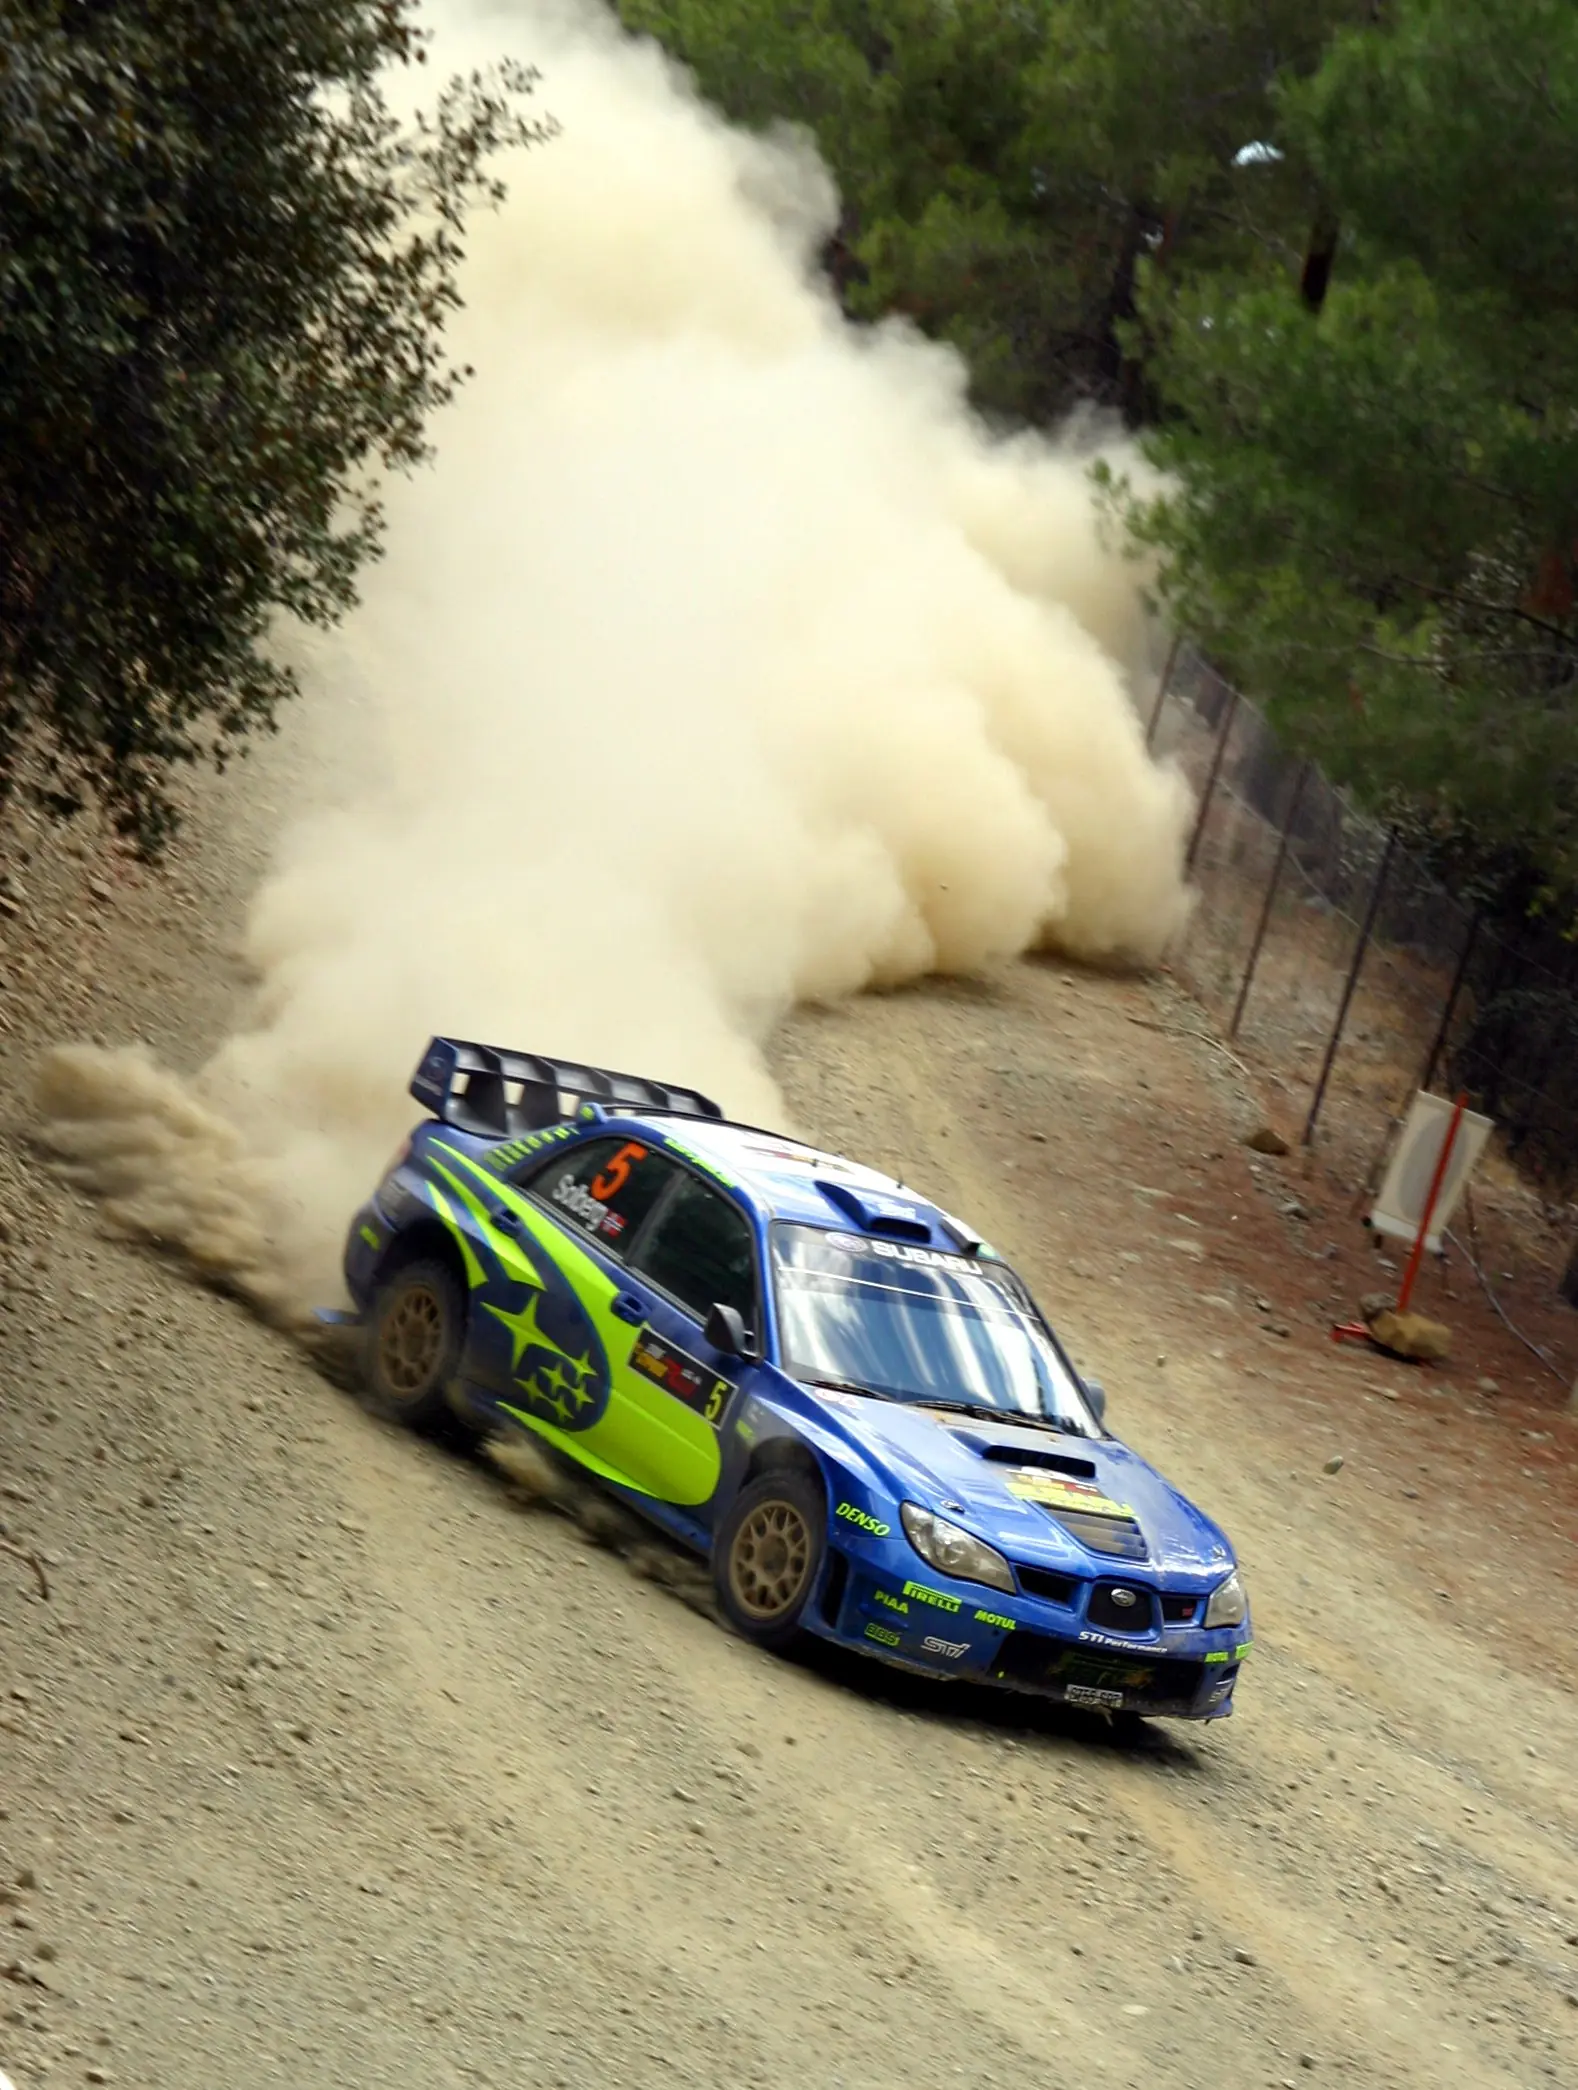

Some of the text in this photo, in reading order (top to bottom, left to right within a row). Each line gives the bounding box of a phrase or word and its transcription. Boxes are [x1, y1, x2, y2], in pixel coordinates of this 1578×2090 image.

[592, 1142, 648, 1200] 5
[871, 1240, 983, 1276] SUBARU
[704, 1380, 728, 1420] 5
[836, 1502, 891, 1536] DENSO
[873, 1590, 909, 1614] PIAA
[902, 1580, 963, 1613] PIRELLI
[974, 1610, 1017, 1630] MOTUL
[1078, 1631, 1104, 1644] STI
